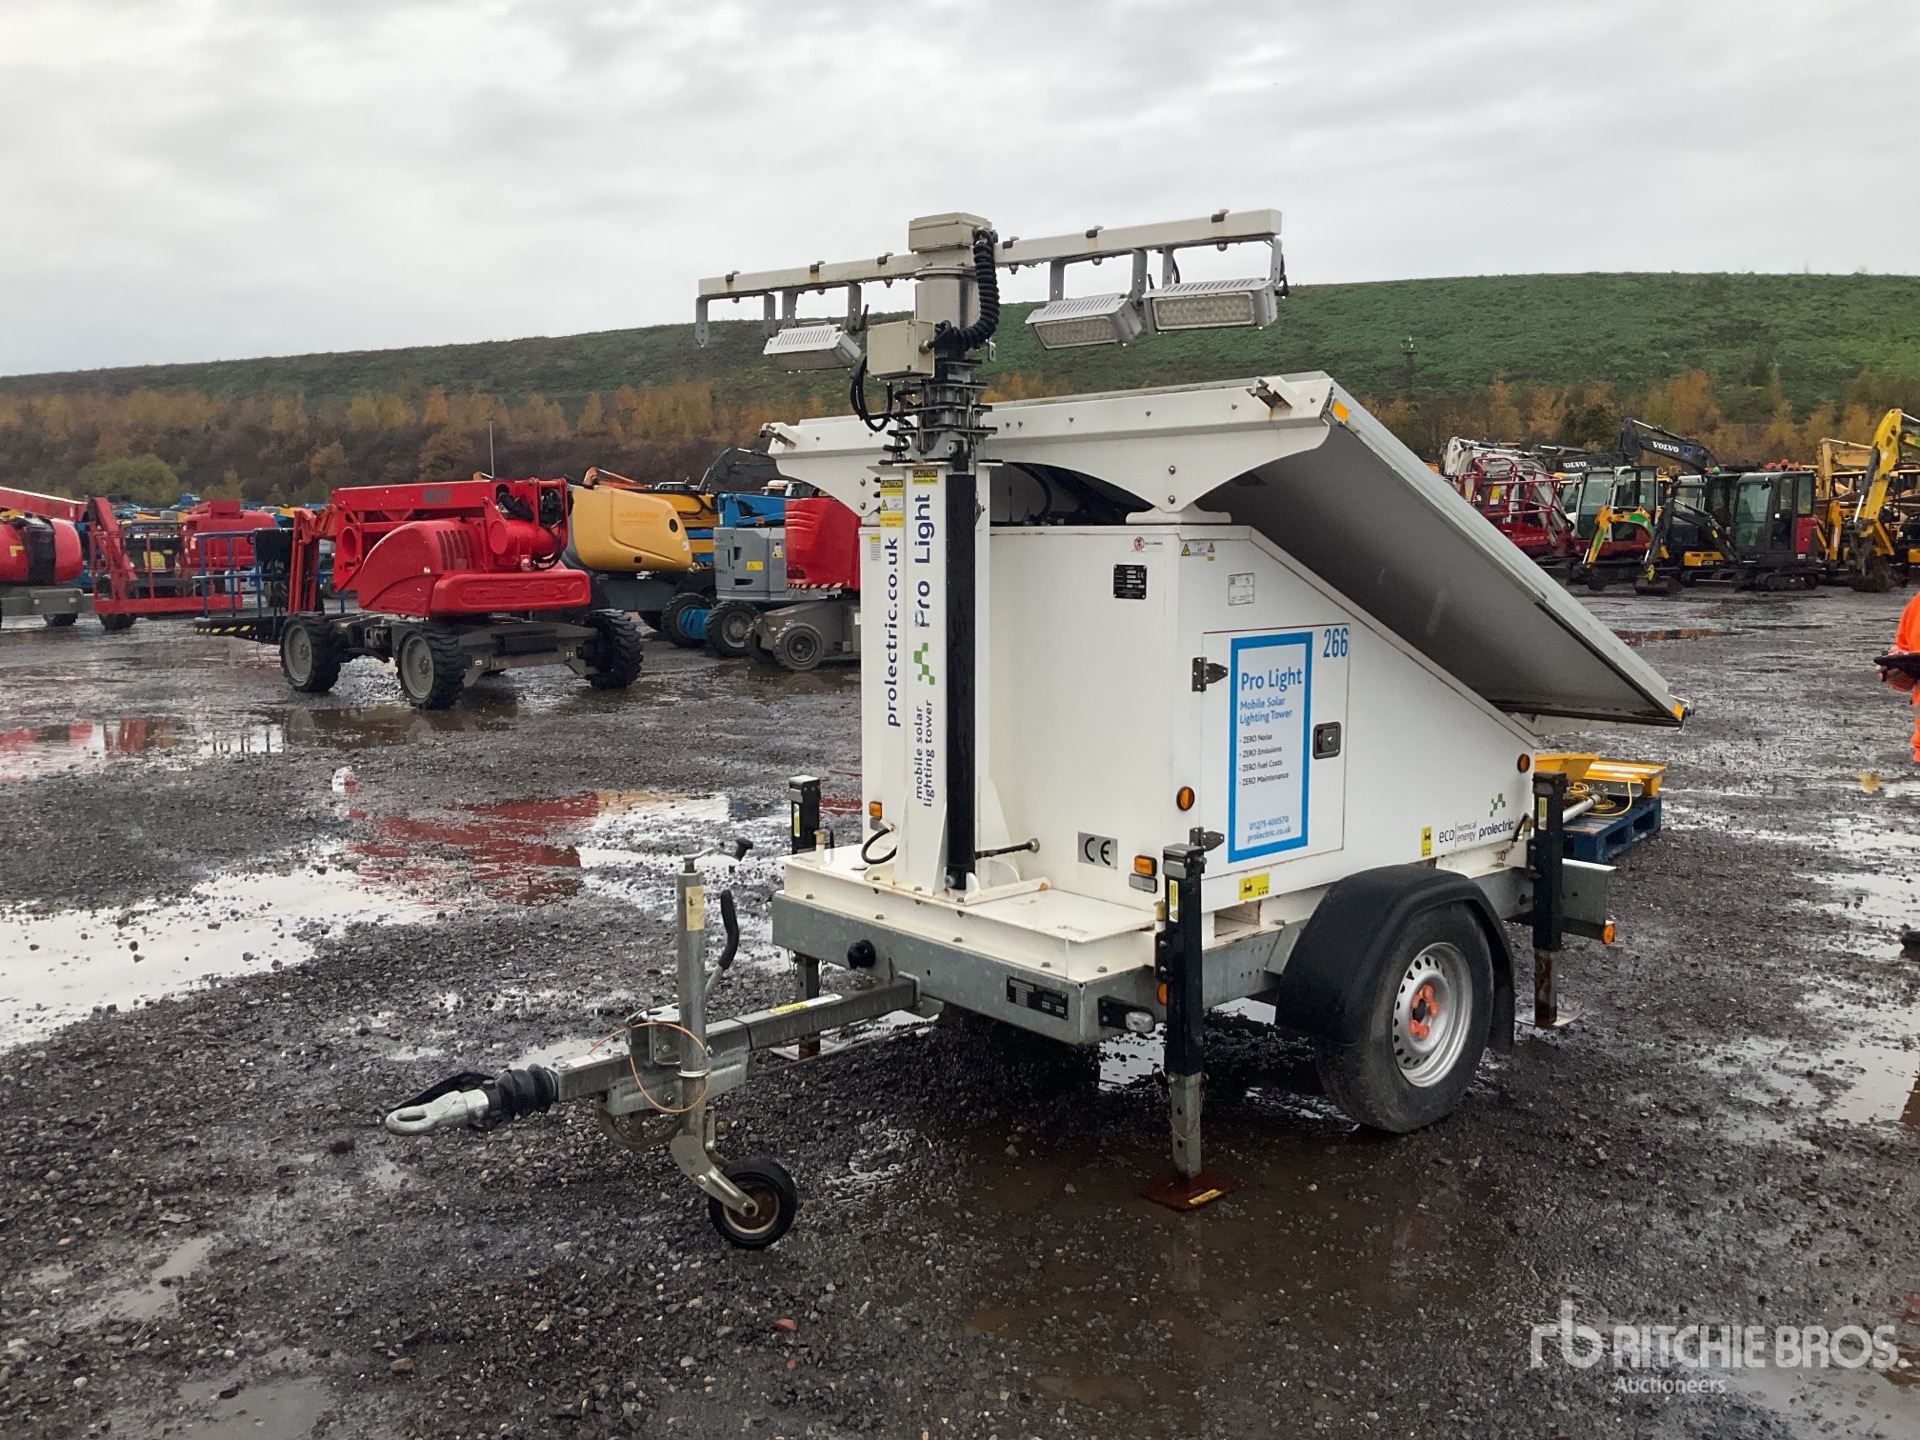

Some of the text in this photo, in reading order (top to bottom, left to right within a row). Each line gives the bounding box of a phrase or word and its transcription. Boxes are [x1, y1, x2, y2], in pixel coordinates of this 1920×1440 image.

[1652, 441, 1680, 453] VOLVO
[880, 480, 904, 488] CAUTION
[915, 494, 934, 563] Light
[915, 581, 930, 628] Pro
[884, 536, 901, 727] prolectric.co.uk
[1323, 627, 1348, 658] 266
[1241, 666, 1303, 691] Pro Light
[1240, 695, 1286, 711] Mobile Solar
[1240, 709, 1293, 727] Lighting Tower
[1242, 733, 1273, 744] ZERO Noise
[914, 705, 923, 800] mobile solar
[923, 699, 935, 808] lighting tower
[1242, 745, 1283, 758] ZERO Emissions
[1242, 758, 1283, 772] ZERO Fuel Costs
[1242, 771, 1290, 786] ZERO Maintenance
[1247, 825, 1291, 844] prolectric.co.uk
[1439, 829, 1455, 843] eco
[1456, 819, 1514, 842] energy prolectric
